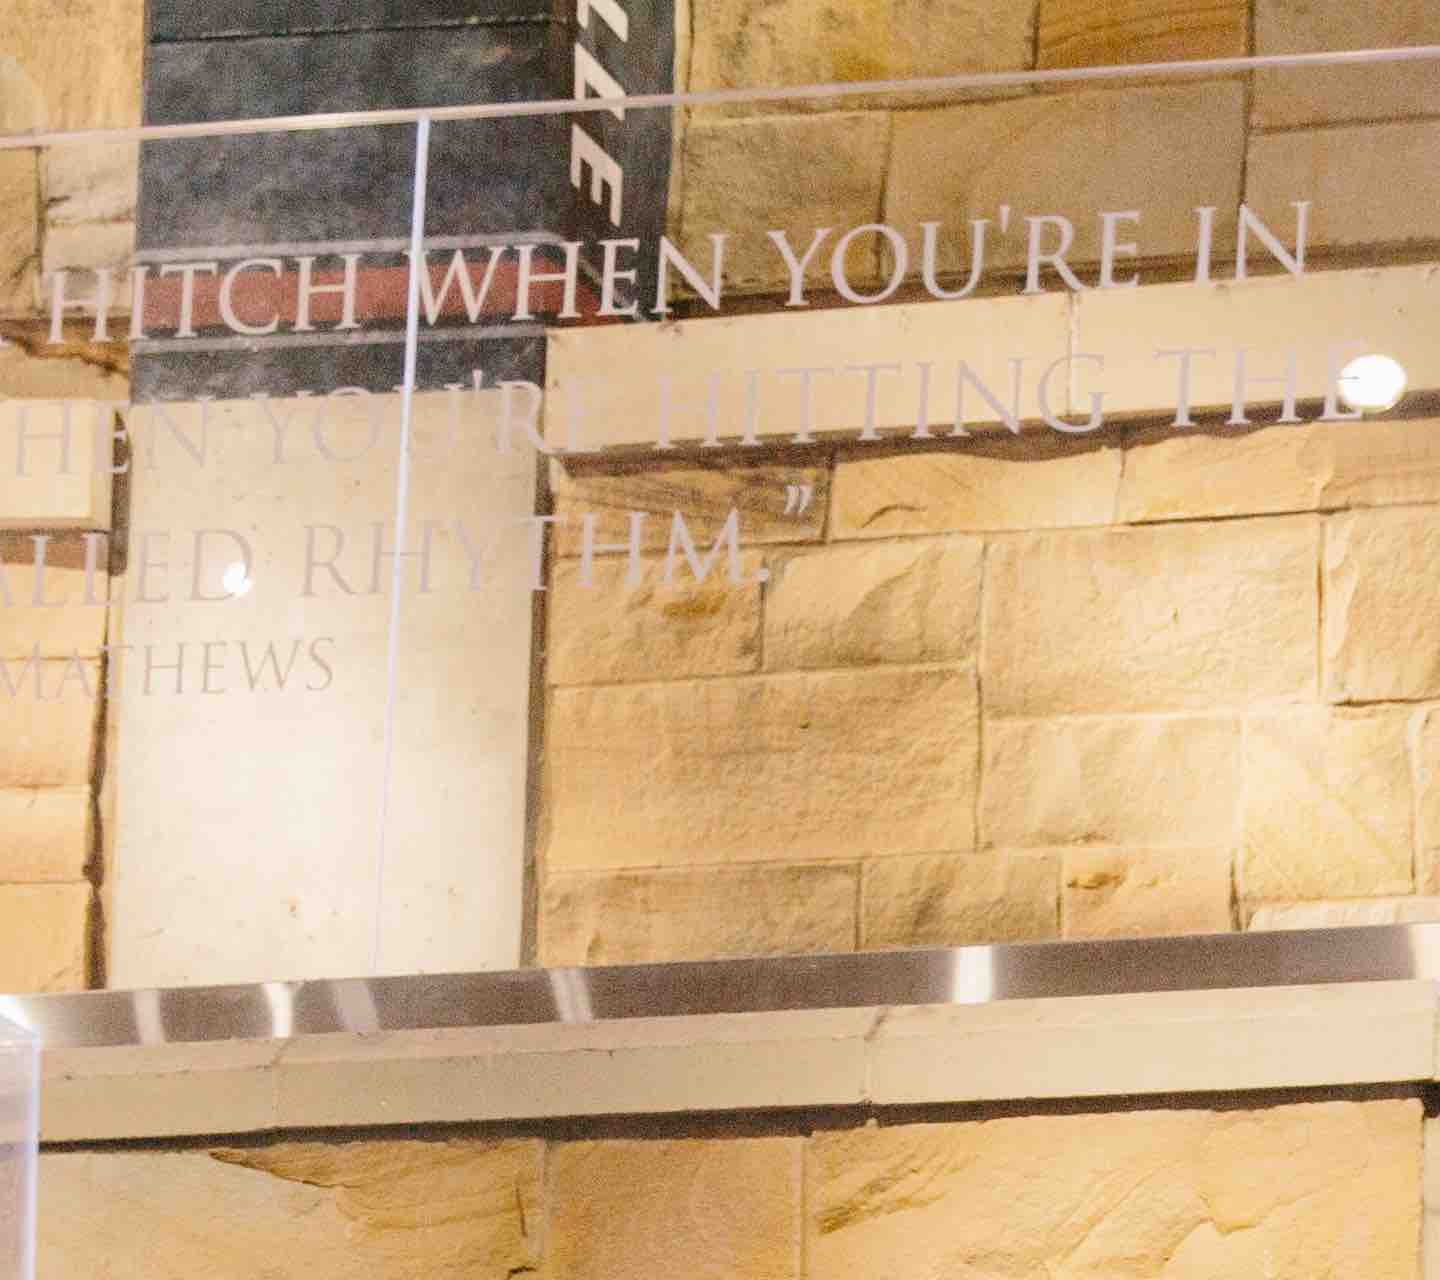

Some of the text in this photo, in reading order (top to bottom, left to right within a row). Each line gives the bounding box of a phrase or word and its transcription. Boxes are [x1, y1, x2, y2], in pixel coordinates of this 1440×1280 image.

[47, 254, 360, 346] HITCH
[410, 232, 728, 327] WHEN
[767, 203, 1142, 308] YOU'RE
[1192, 200, 1312, 283] IN
[250, 368, 610, 464] YOU'RE
[652, 350, 1109, 450] HITTING
[1153, 342, 1367, 427] THE
